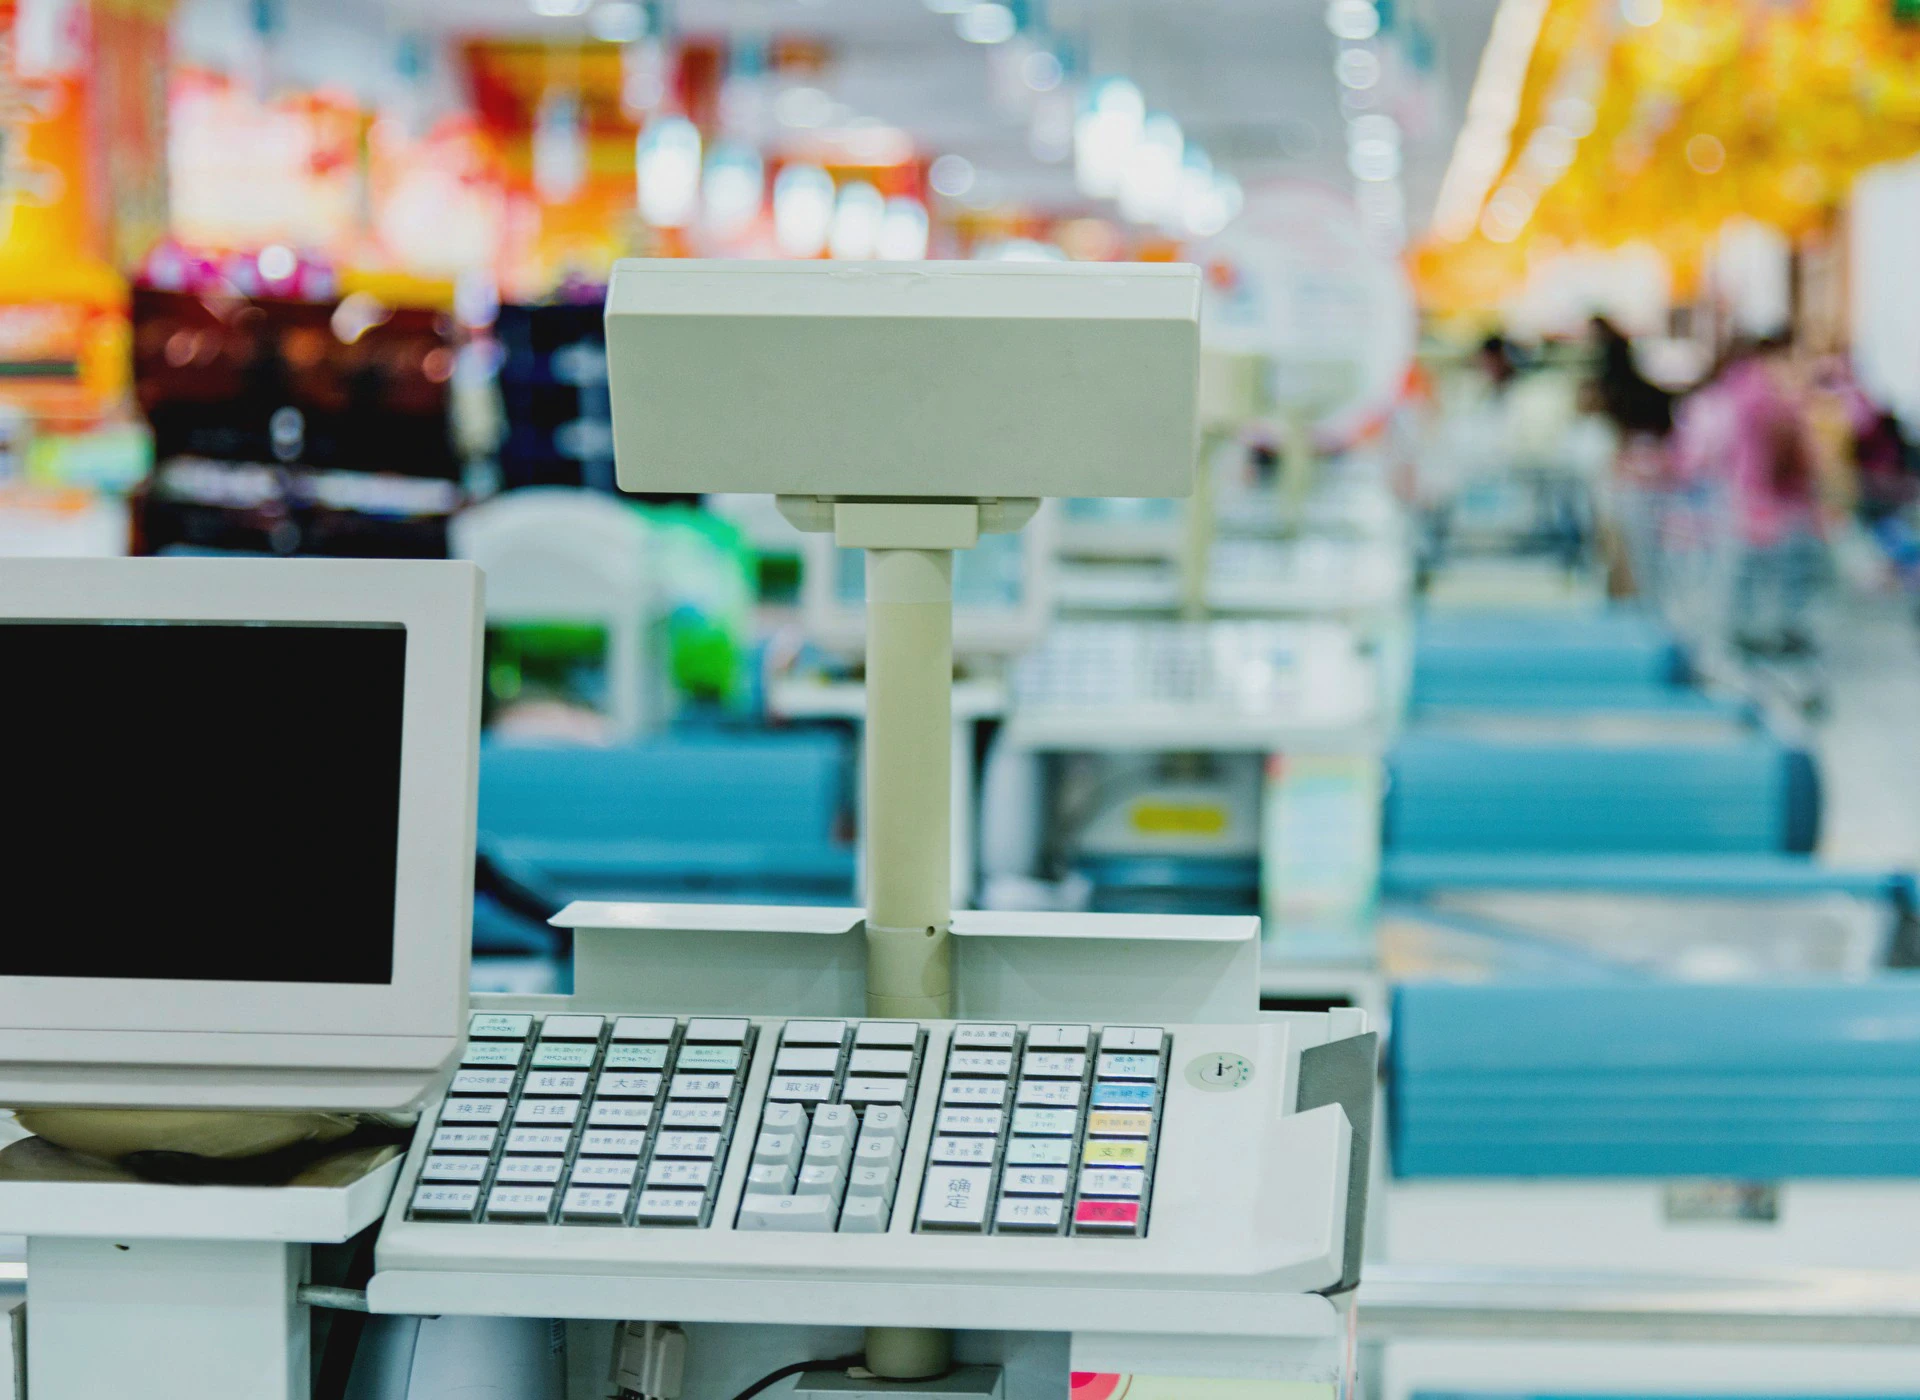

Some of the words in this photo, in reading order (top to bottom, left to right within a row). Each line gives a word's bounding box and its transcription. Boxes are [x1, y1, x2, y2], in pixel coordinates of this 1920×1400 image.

[539, 1077, 576, 1088] 钱箱
[612, 1078, 649, 1089] 大宗
[685, 1080, 722, 1091] 挂单
[785, 1082, 821, 1093] 取消
[456, 1103, 493, 1115] 换班
[532, 1104, 567, 1115] 日结
[778, 1110, 789, 1119] 7
[827, 1111, 838, 1120] 8
[876, 1113, 888, 1121] 9
[771, 1140, 781, 1149] 4
[821, 1140, 831, 1149] 5
[870, 1142, 881, 1151] 6
[815, 1170, 825, 1178] 2
[864, 1171, 876, 1179] 3
[1019, 1174, 1055, 1185] 数量
[944, 1178, 972, 1210] 确定
[1013, 1205, 1050, 1216] 付款
